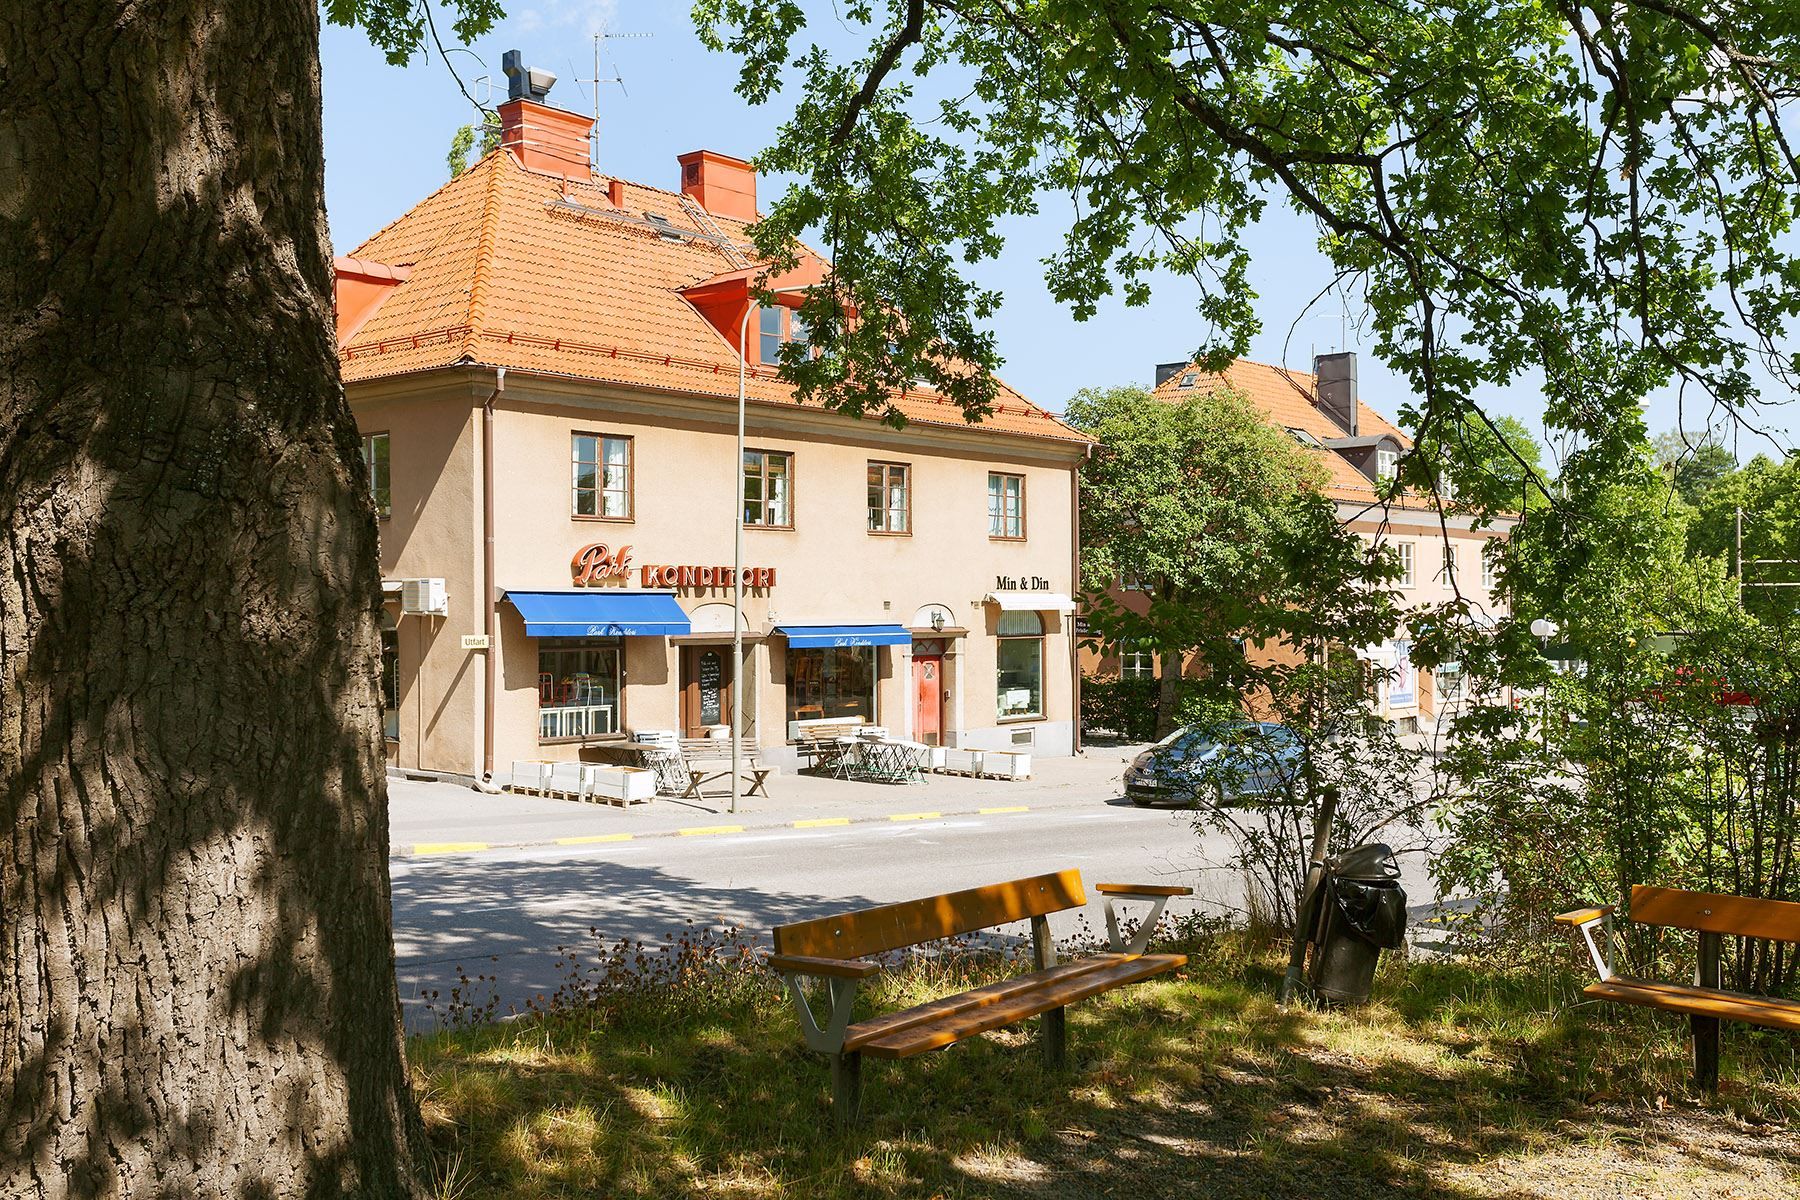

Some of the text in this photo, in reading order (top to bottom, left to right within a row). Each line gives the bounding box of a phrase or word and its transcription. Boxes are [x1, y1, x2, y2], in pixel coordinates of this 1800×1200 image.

[571, 542, 777, 588] Park KONDITORI
[996, 575, 1049, 591] Min & Din
[465, 638, 485, 646] Utfart
